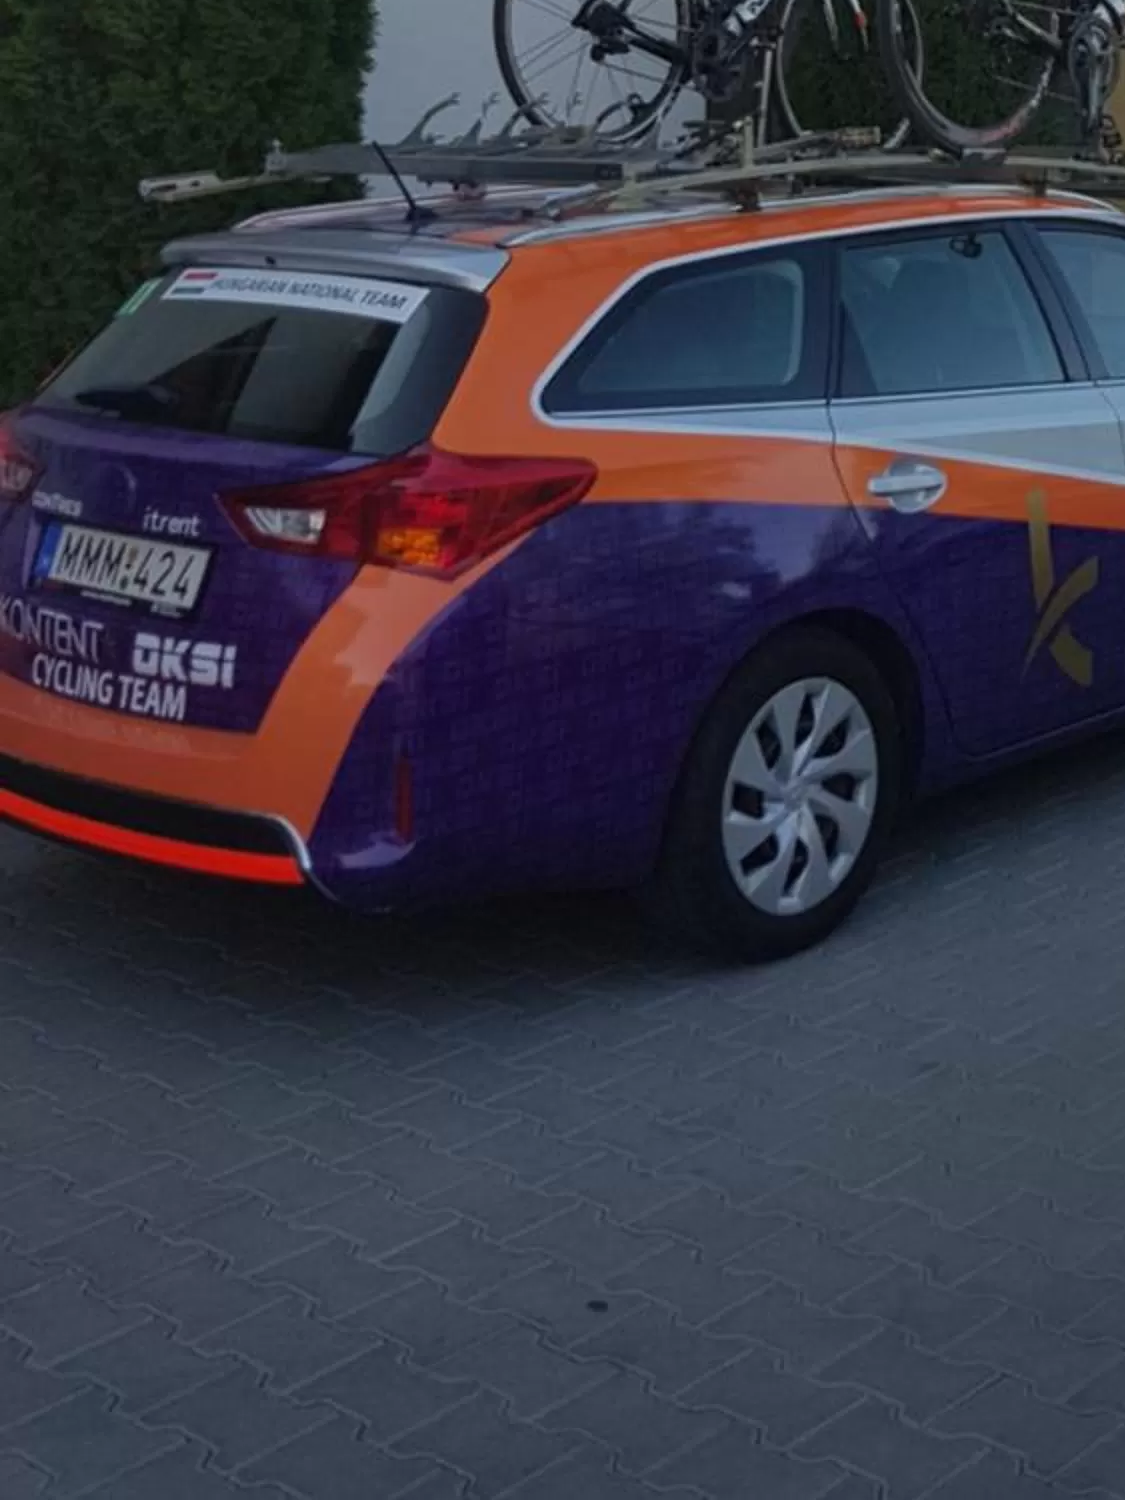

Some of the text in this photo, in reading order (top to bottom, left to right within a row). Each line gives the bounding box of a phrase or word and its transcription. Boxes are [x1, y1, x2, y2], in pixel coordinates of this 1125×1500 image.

[288, 281, 361, 302] NATIONAL
[359, 290, 409, 309] TEAM
[32, 652, 188, 721] CYCLING TEAM
